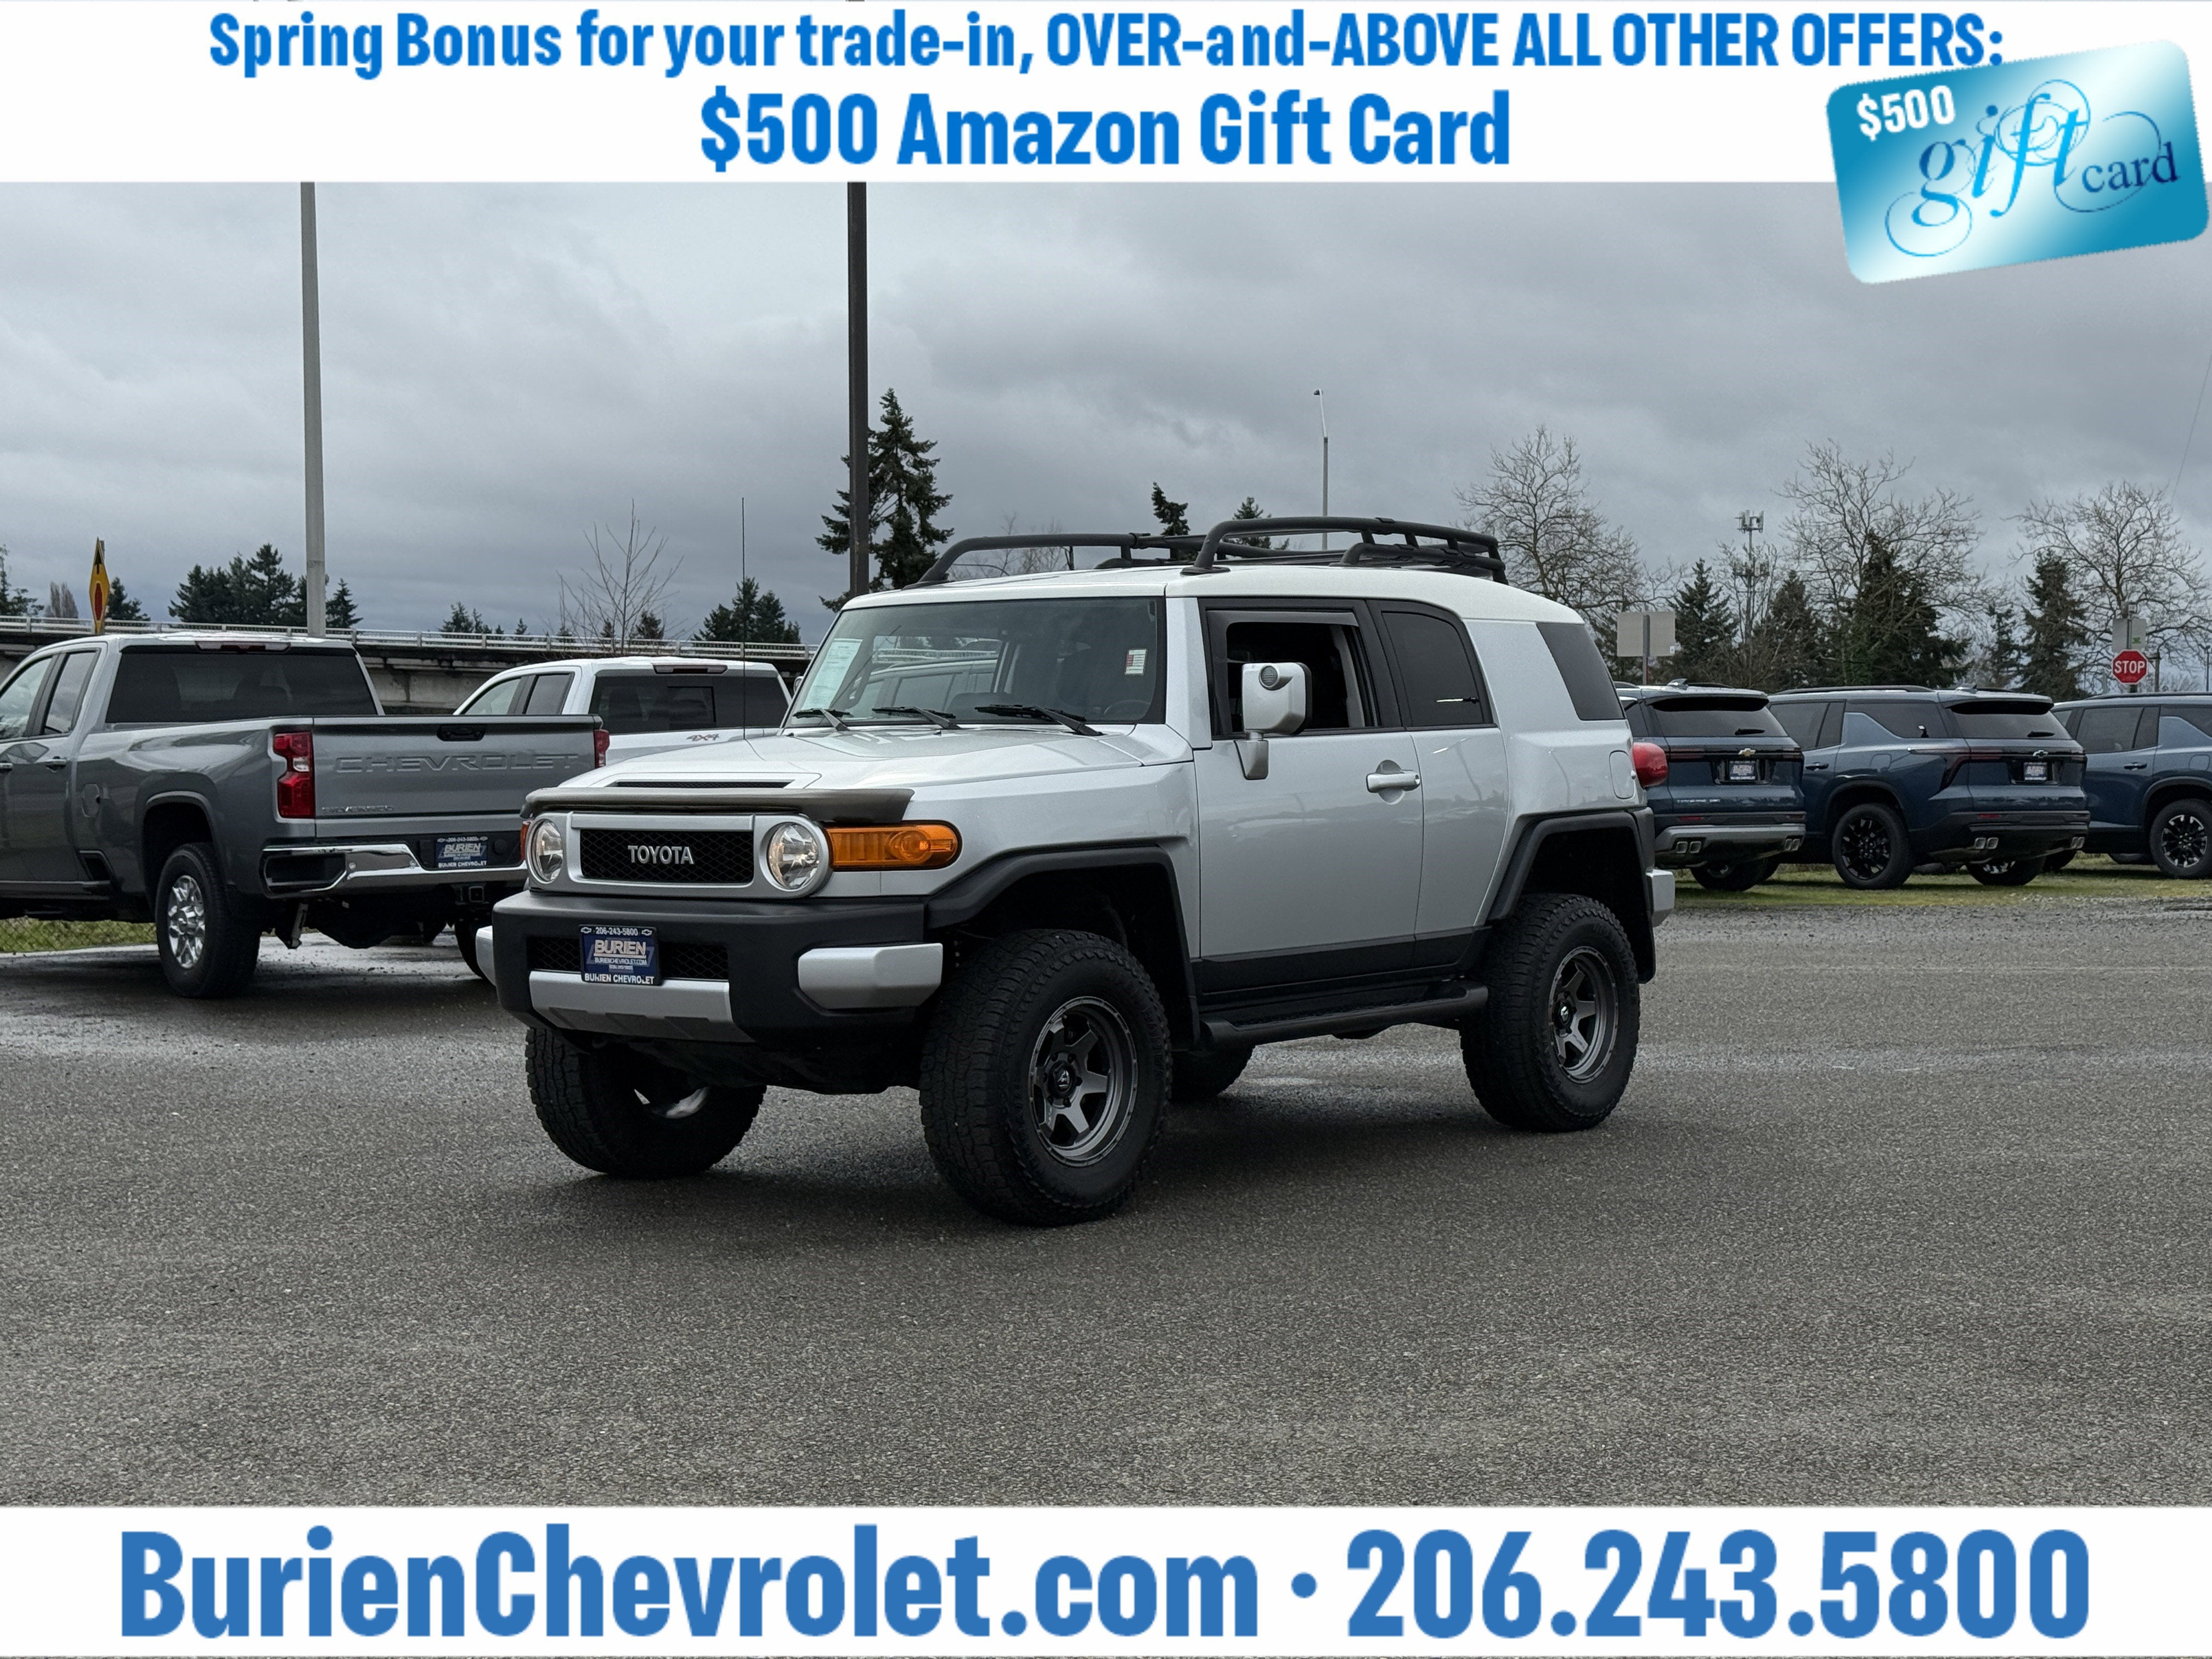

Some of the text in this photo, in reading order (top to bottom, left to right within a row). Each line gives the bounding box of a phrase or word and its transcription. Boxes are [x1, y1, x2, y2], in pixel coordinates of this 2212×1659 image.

[2114, 660, 2146, 674] STOP
[334, 753, 579, 772] CHEVROLET
[444, 843, 481, 854] BURIEN
[628, 845, 695, 865] TOYOTA
[595, 926, 639, 936] 206-243-5800
[594, 939, 646, 955] BURIEN
